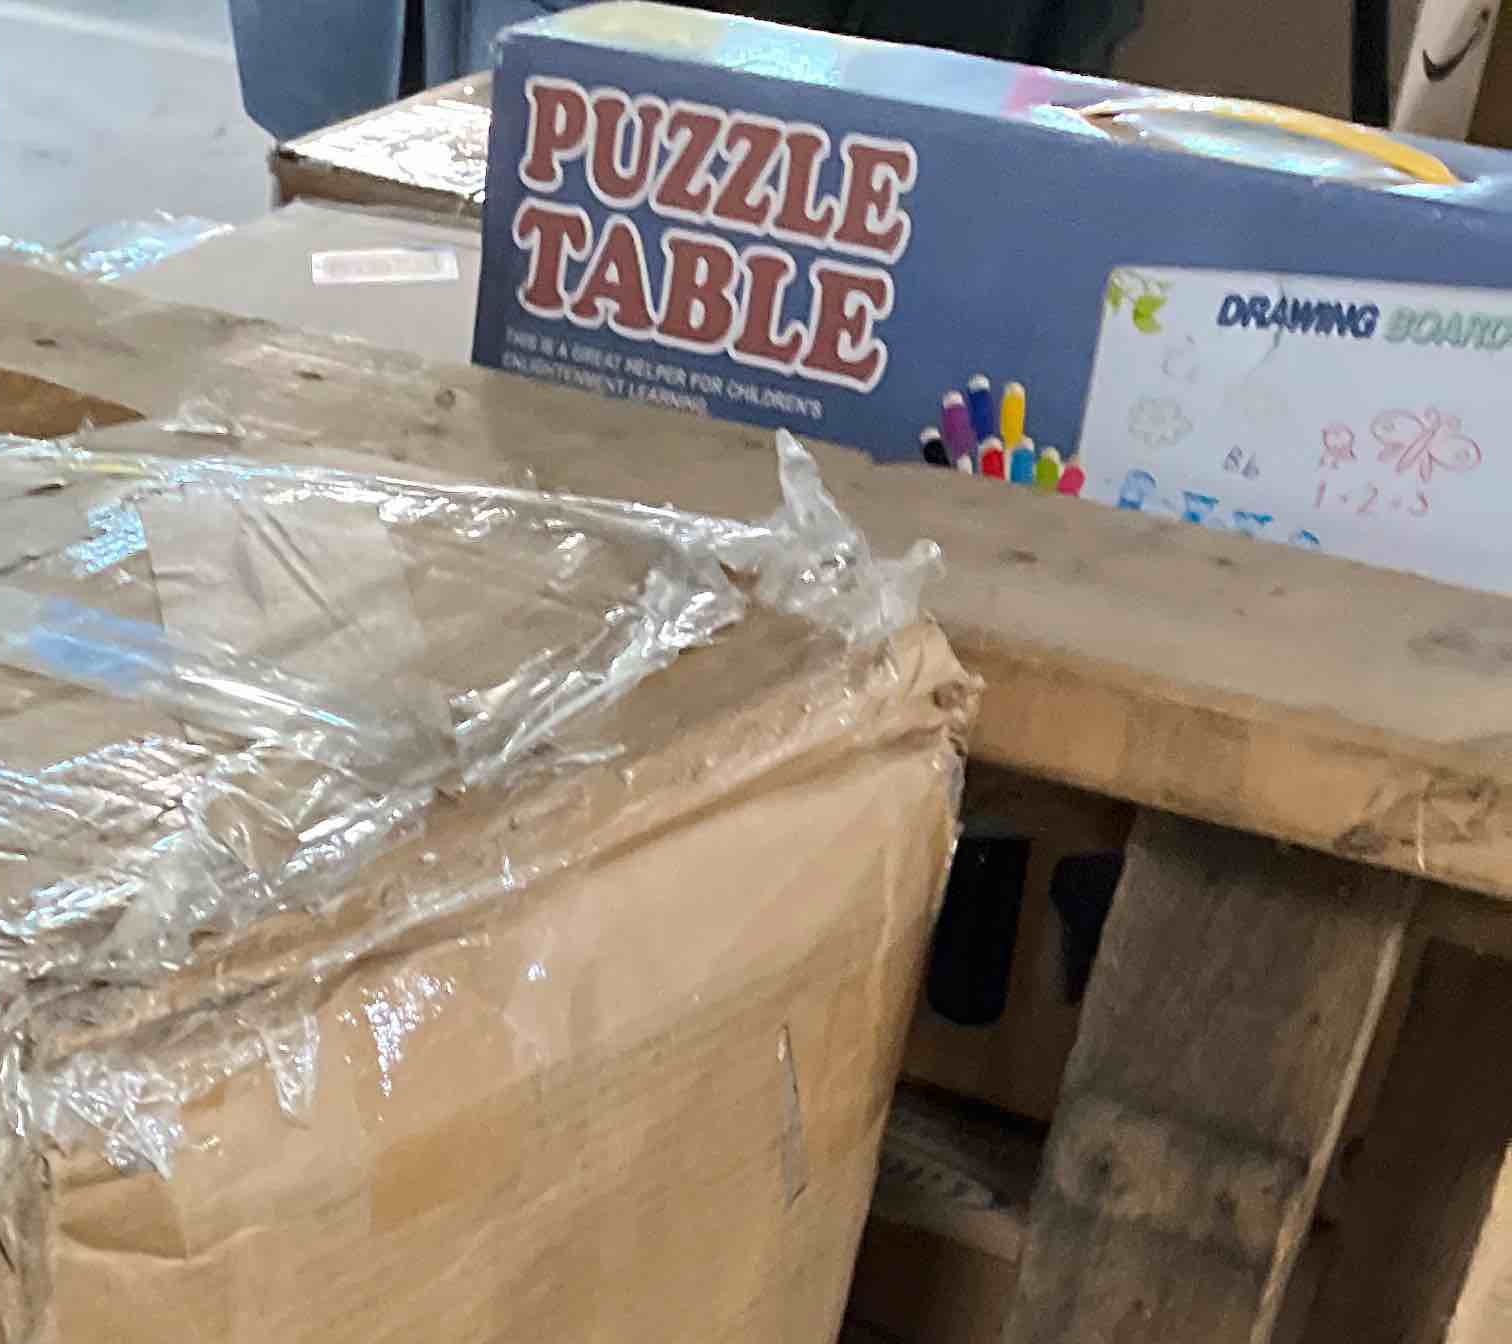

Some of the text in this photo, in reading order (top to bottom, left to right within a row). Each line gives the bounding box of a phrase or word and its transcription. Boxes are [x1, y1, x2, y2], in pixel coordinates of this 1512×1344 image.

[519, 75, 918, 264] PUZZLE
[513, 197, 894, 393] TABLE
[1217, 294, 1512, 351] DRAWING BOARD
[623, 353, 689, 388] HELPER
[690, 369, 724, 397] FOR
[726, 378, 825, 420] CHILDREN'S
